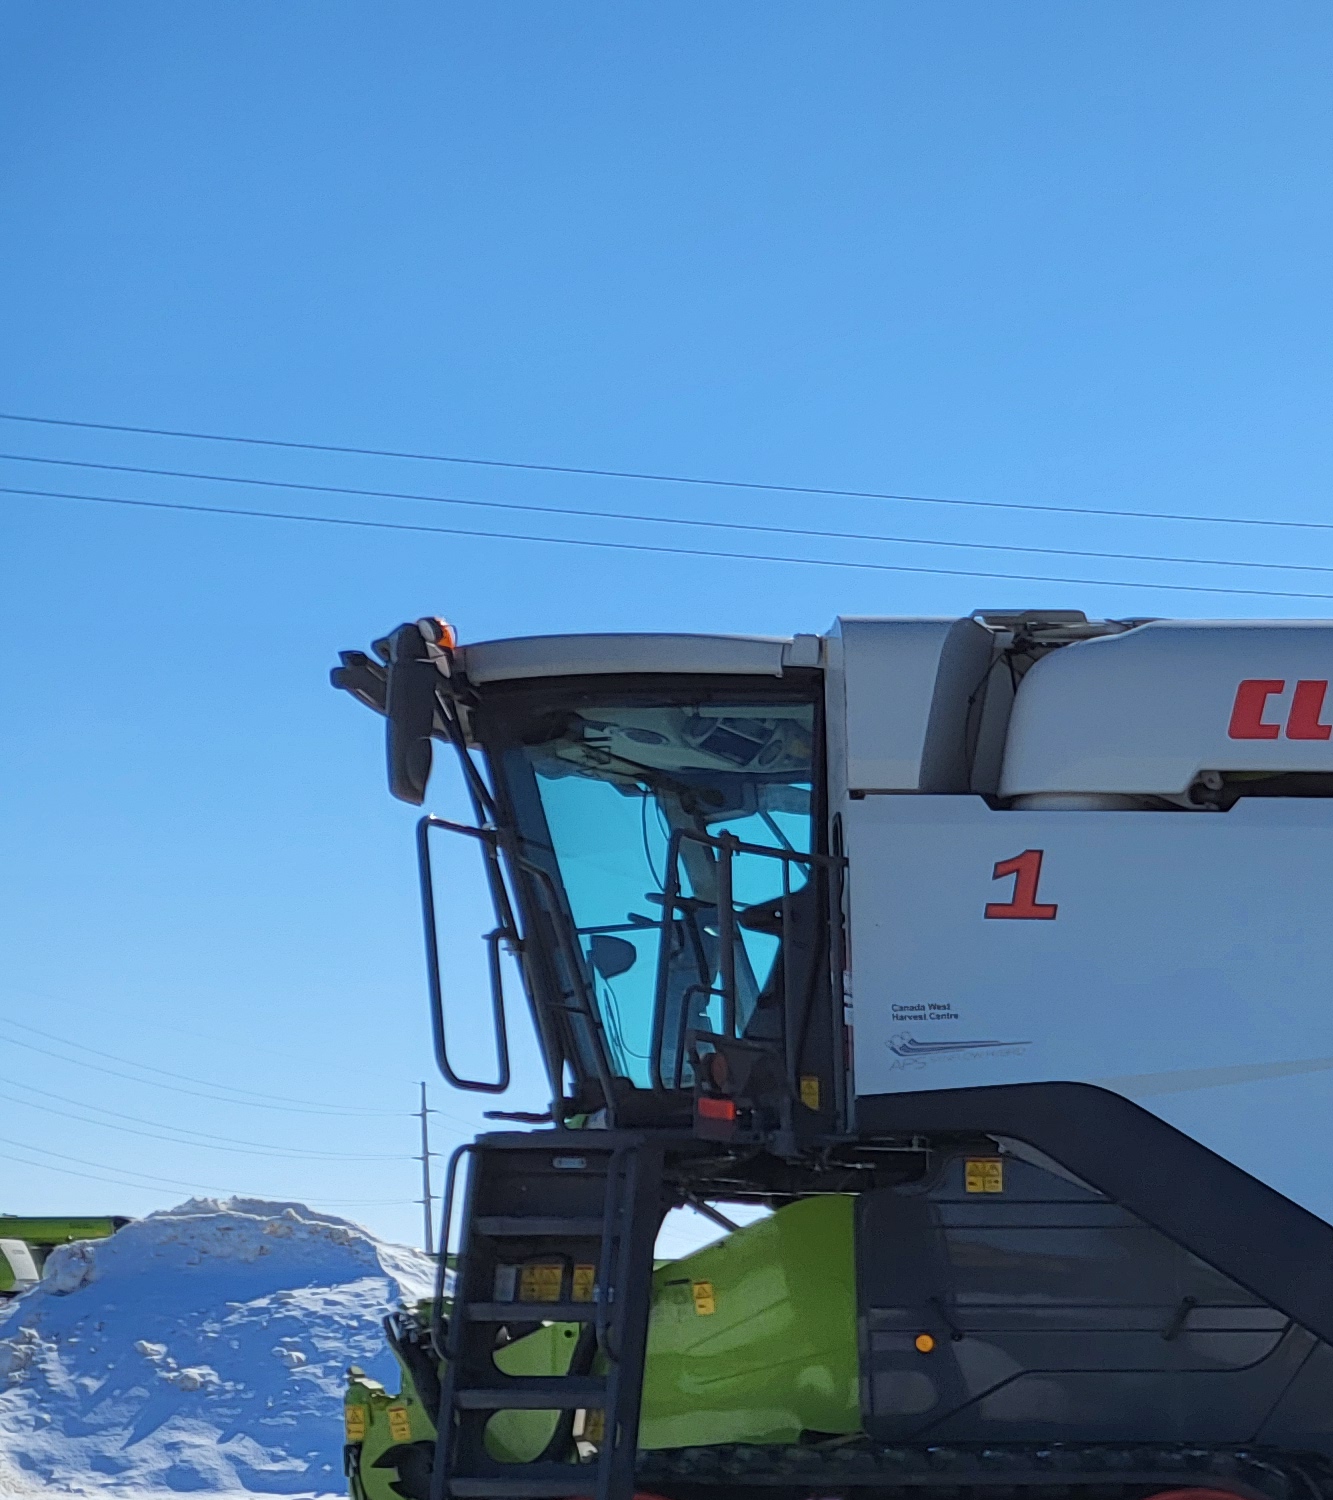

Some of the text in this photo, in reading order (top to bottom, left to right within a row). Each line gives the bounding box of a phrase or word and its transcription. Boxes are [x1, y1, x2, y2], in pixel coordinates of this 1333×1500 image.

[984, 849, 1058, 920] 1
[891, 1002, 951, 1012] Canada West
[891, 1012, 959, 1021] Harvest Centre
